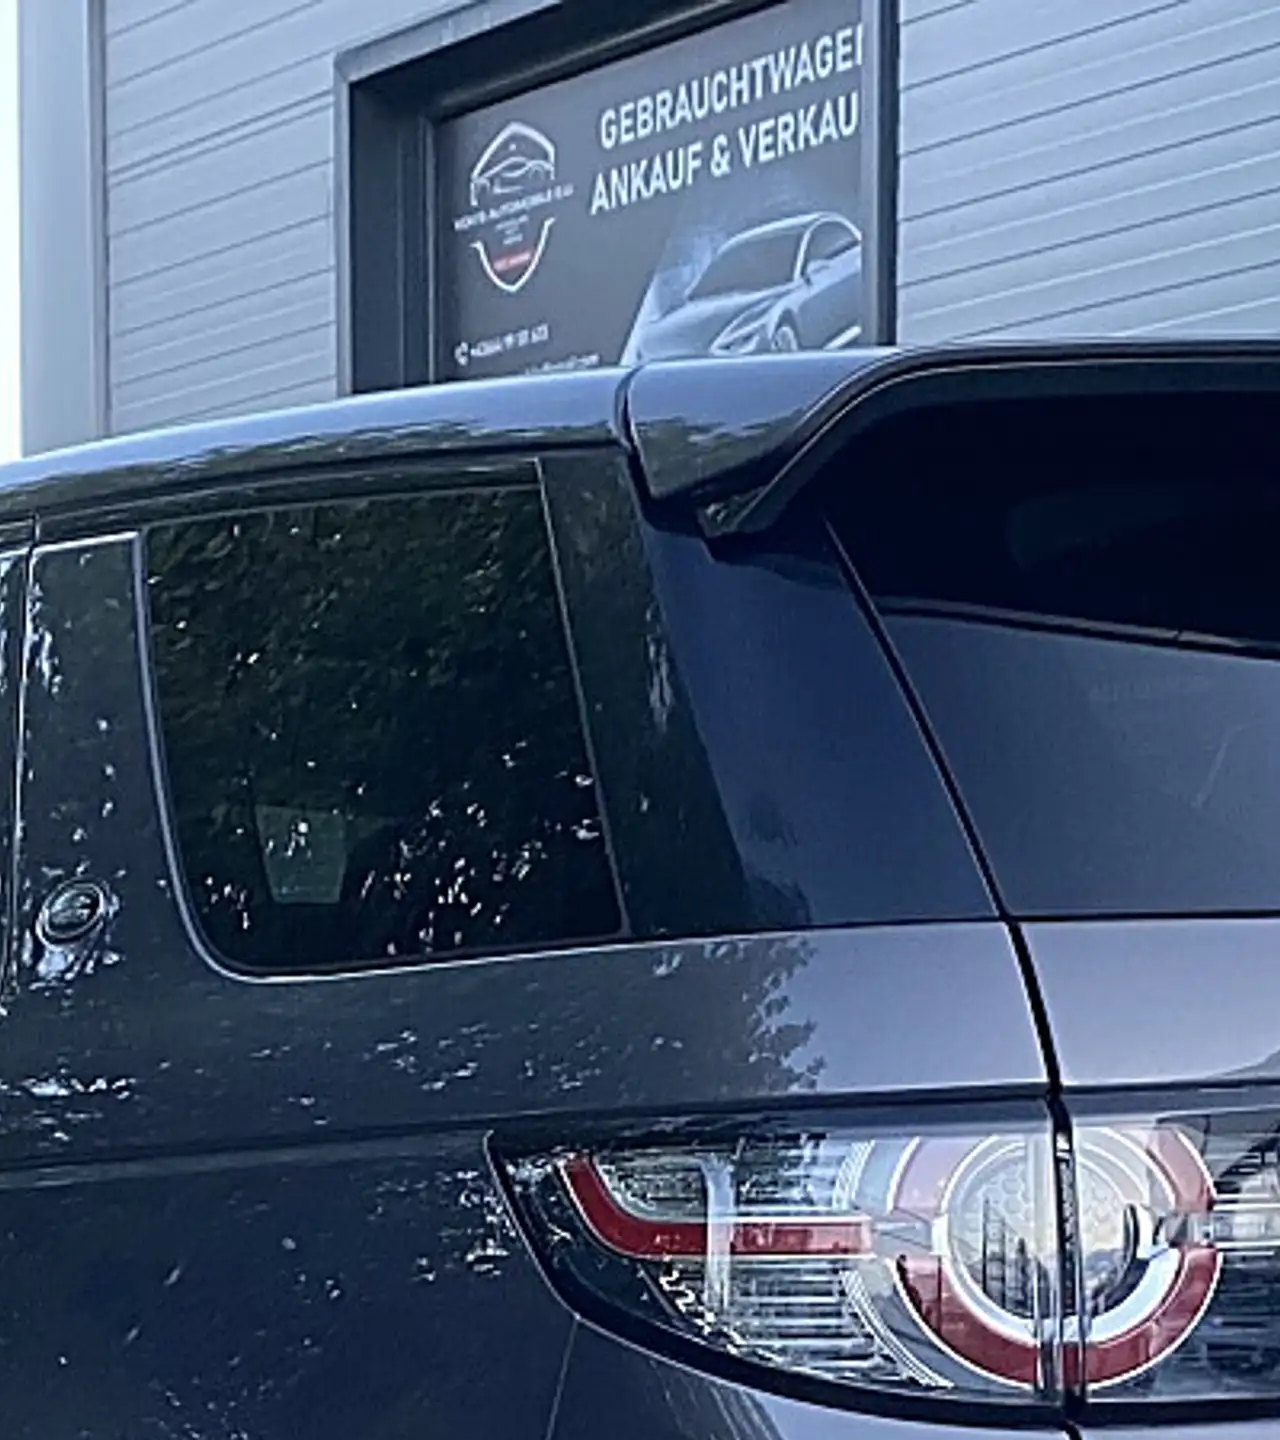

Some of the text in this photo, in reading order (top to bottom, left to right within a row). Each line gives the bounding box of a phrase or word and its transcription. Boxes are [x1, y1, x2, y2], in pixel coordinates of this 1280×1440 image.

[590, 91, 859, 215] ANKAUF & VERKAU
